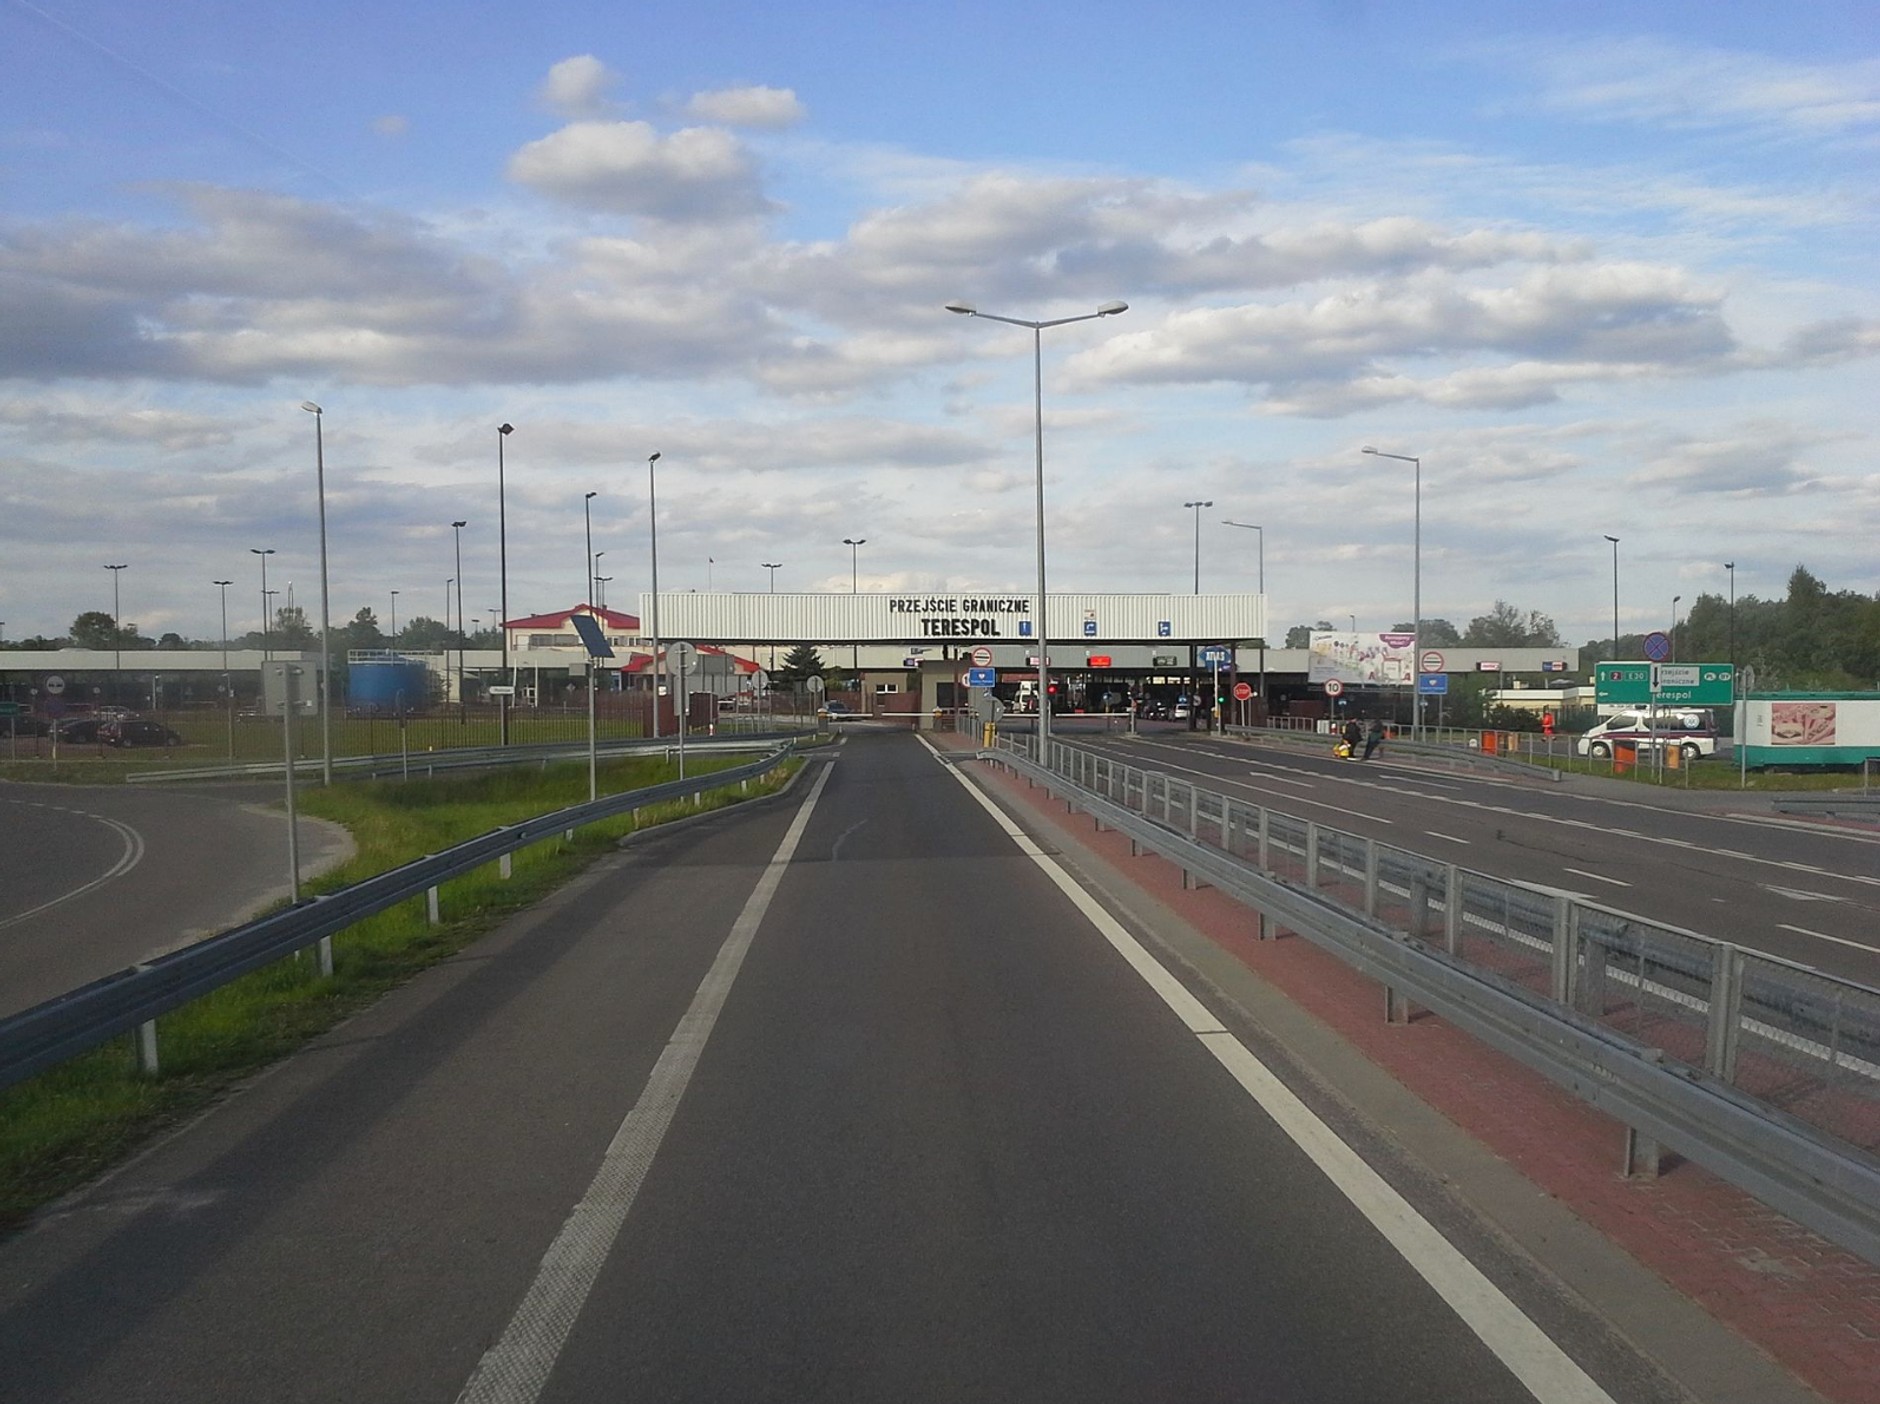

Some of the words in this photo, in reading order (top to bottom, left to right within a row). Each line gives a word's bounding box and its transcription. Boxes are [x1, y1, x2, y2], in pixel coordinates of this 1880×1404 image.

[890, 597, 957, 613] PRZEJŚCIE
[963, 599, 1030, 613] GRANICZNE
[921, 619, 1001, 636] TERESPOL
[1328, 683, 1339, 692] 10
[1656, 691, 1692, 700] erespol
